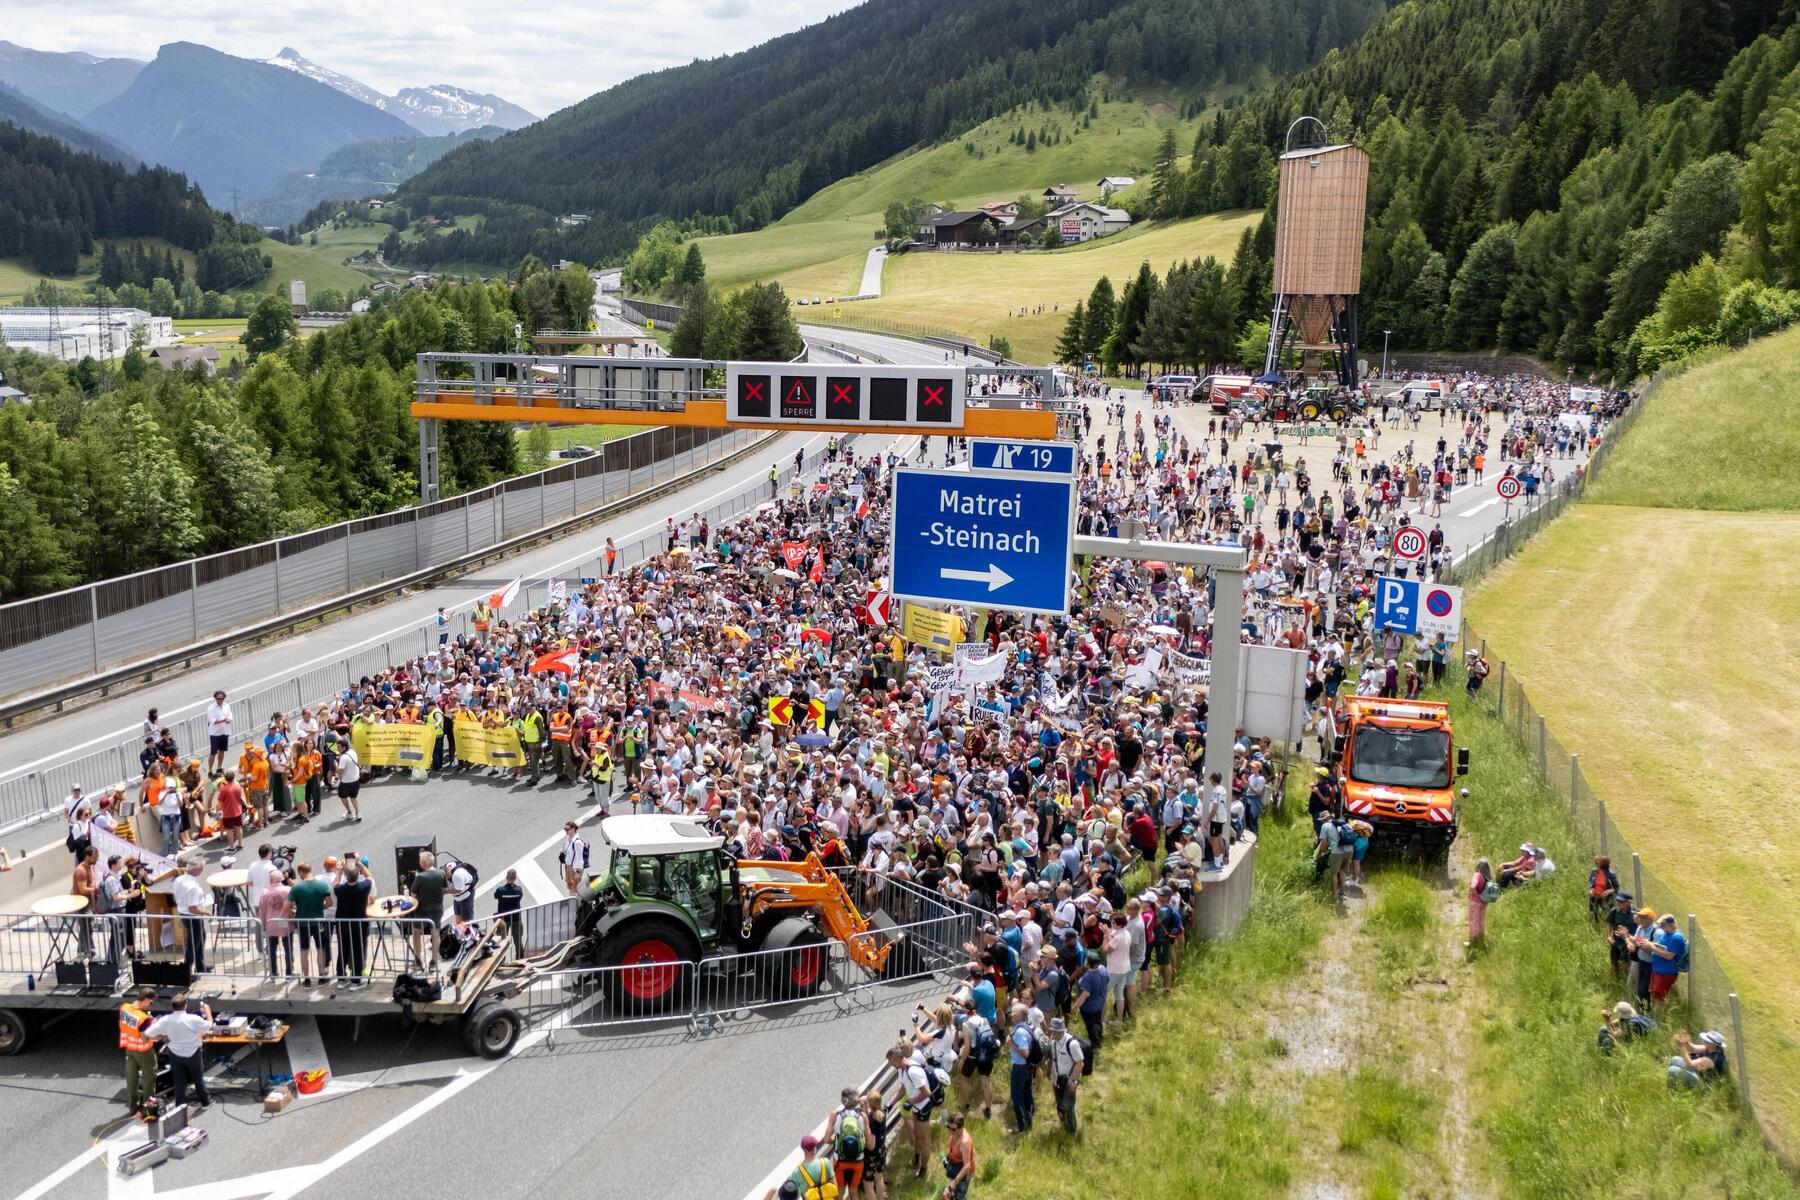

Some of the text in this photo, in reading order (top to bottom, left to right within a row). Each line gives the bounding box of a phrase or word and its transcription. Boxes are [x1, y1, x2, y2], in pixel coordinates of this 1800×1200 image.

[783, 408, 814, 416] SPERRE
[1031, 449, 1053, 469] 19
[1502, 482, 1516, 494] 60
[939, 489, 1021, 518] Matrei
[920, 522, 1040, 554] -Steinach
[1401, 535, 1419, 551] 80
[1383, 580, 1404, 614] P
[930, 668, 955, 679] GENUG
